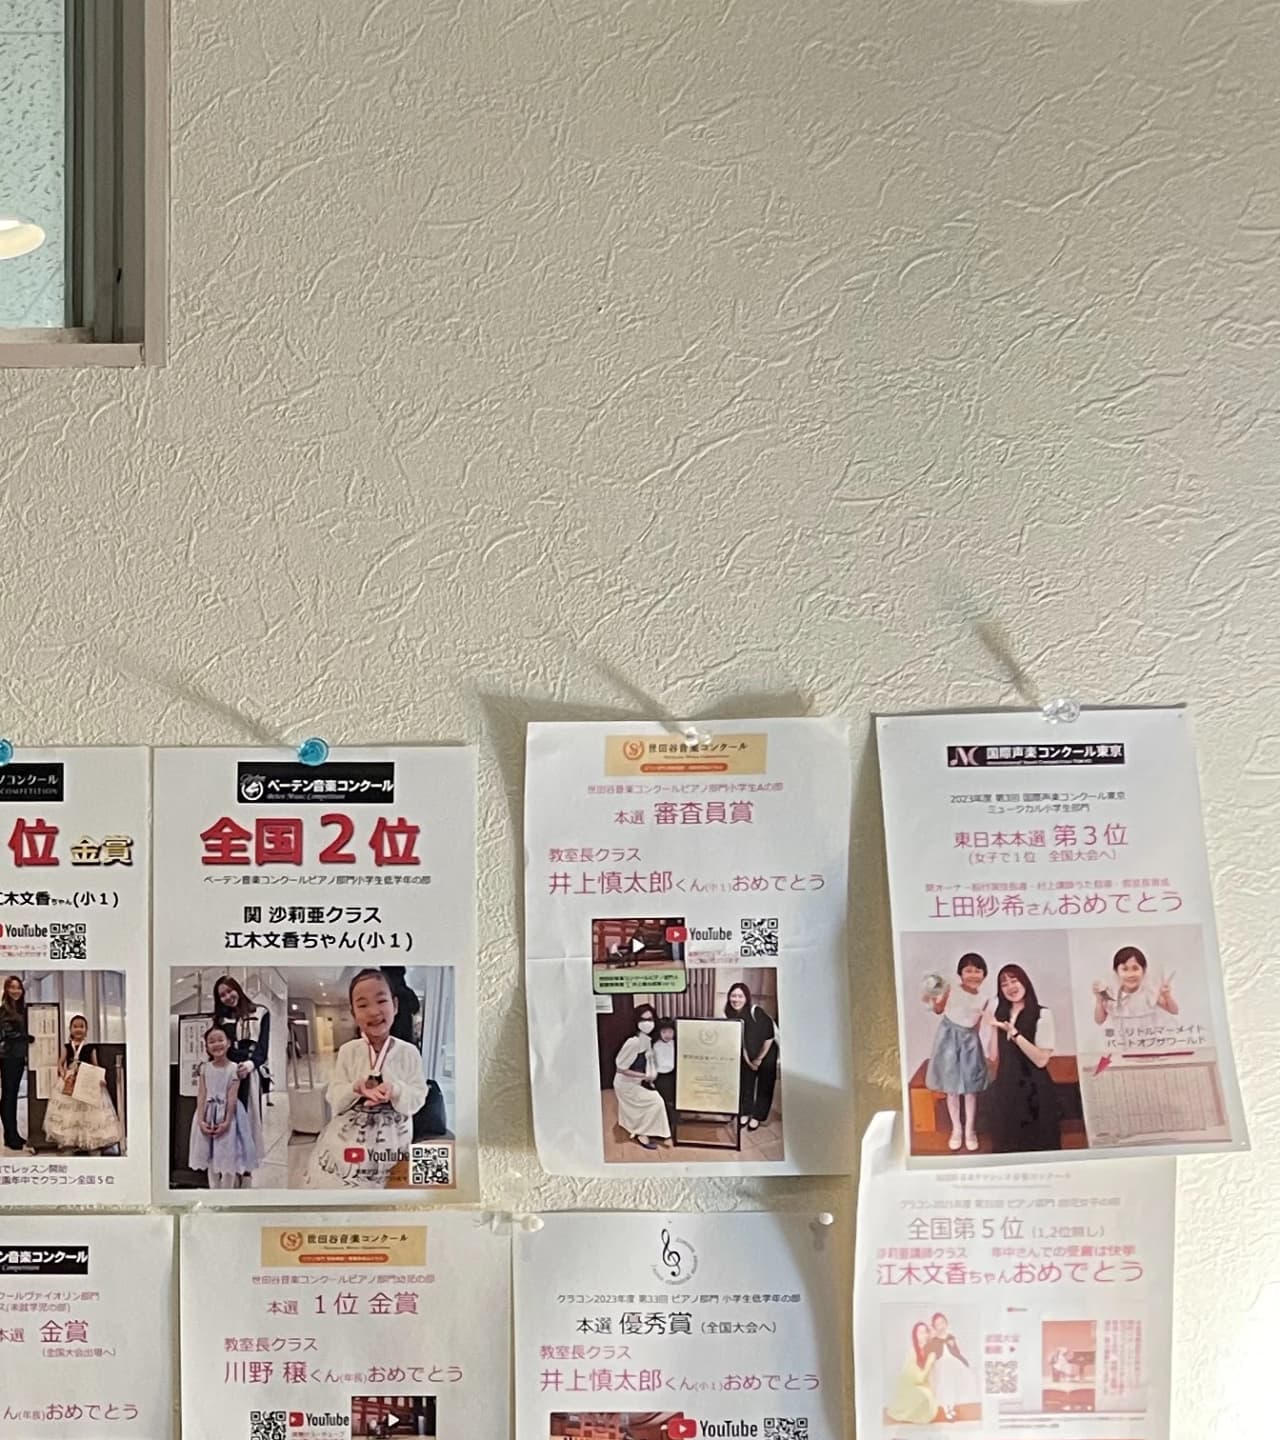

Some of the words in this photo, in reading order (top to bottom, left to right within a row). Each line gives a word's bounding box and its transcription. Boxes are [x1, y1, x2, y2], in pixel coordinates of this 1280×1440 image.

[986, 744, 1124, 761] 国際声楽コンクール東京
[267, 778, 394, 794] ベーテン音楽コンクール
[614, 809, 645, 825] 本選
[654, 800, 754, 826] 審査員賞
[953, 830, 1046, 849] 東日本本選
[1053, 822, 1129, 848] 第3位
[70, 834, 135, 867] 金賞
[548, 847, 642, 863] 教室長クラス
[928, 890, 1184, 919] 上田紗希さんおめでとう
[243, 906, 261, 924] 関
[269, 906, 383, 925] 沙莉亜クラス
[4, 922, 48, 939] YouTube
[689, 926, 733, 942] YouTube
[367, 1146, 410, 1163] YouTube
[307, 1231, 409, 1245] 世田谷音楽コンクール
[877, 1260, 1145, 1285] 江木文香ちゃんおめでとう
[266, 1300, 298, 1315] 本選
[314, 1293, 360, 1315] 1位
[368, 1291, 419, 1316] 金賞
[671, 1293, 720, 1305] ピアノ部門
[39, 1319, 89, 1343] 金賞
[576, 1317, 612, 1334] 本選
[619, 1311, 693, 1335] 優秀賞
[224, 1336, 318, 1353] 教室長クラス
[540, 1344, 632, 1360] 教室長クラス
[306, 1411, 350, 1427] YouTube
[699, 1419, 758, 1438] YouTube
